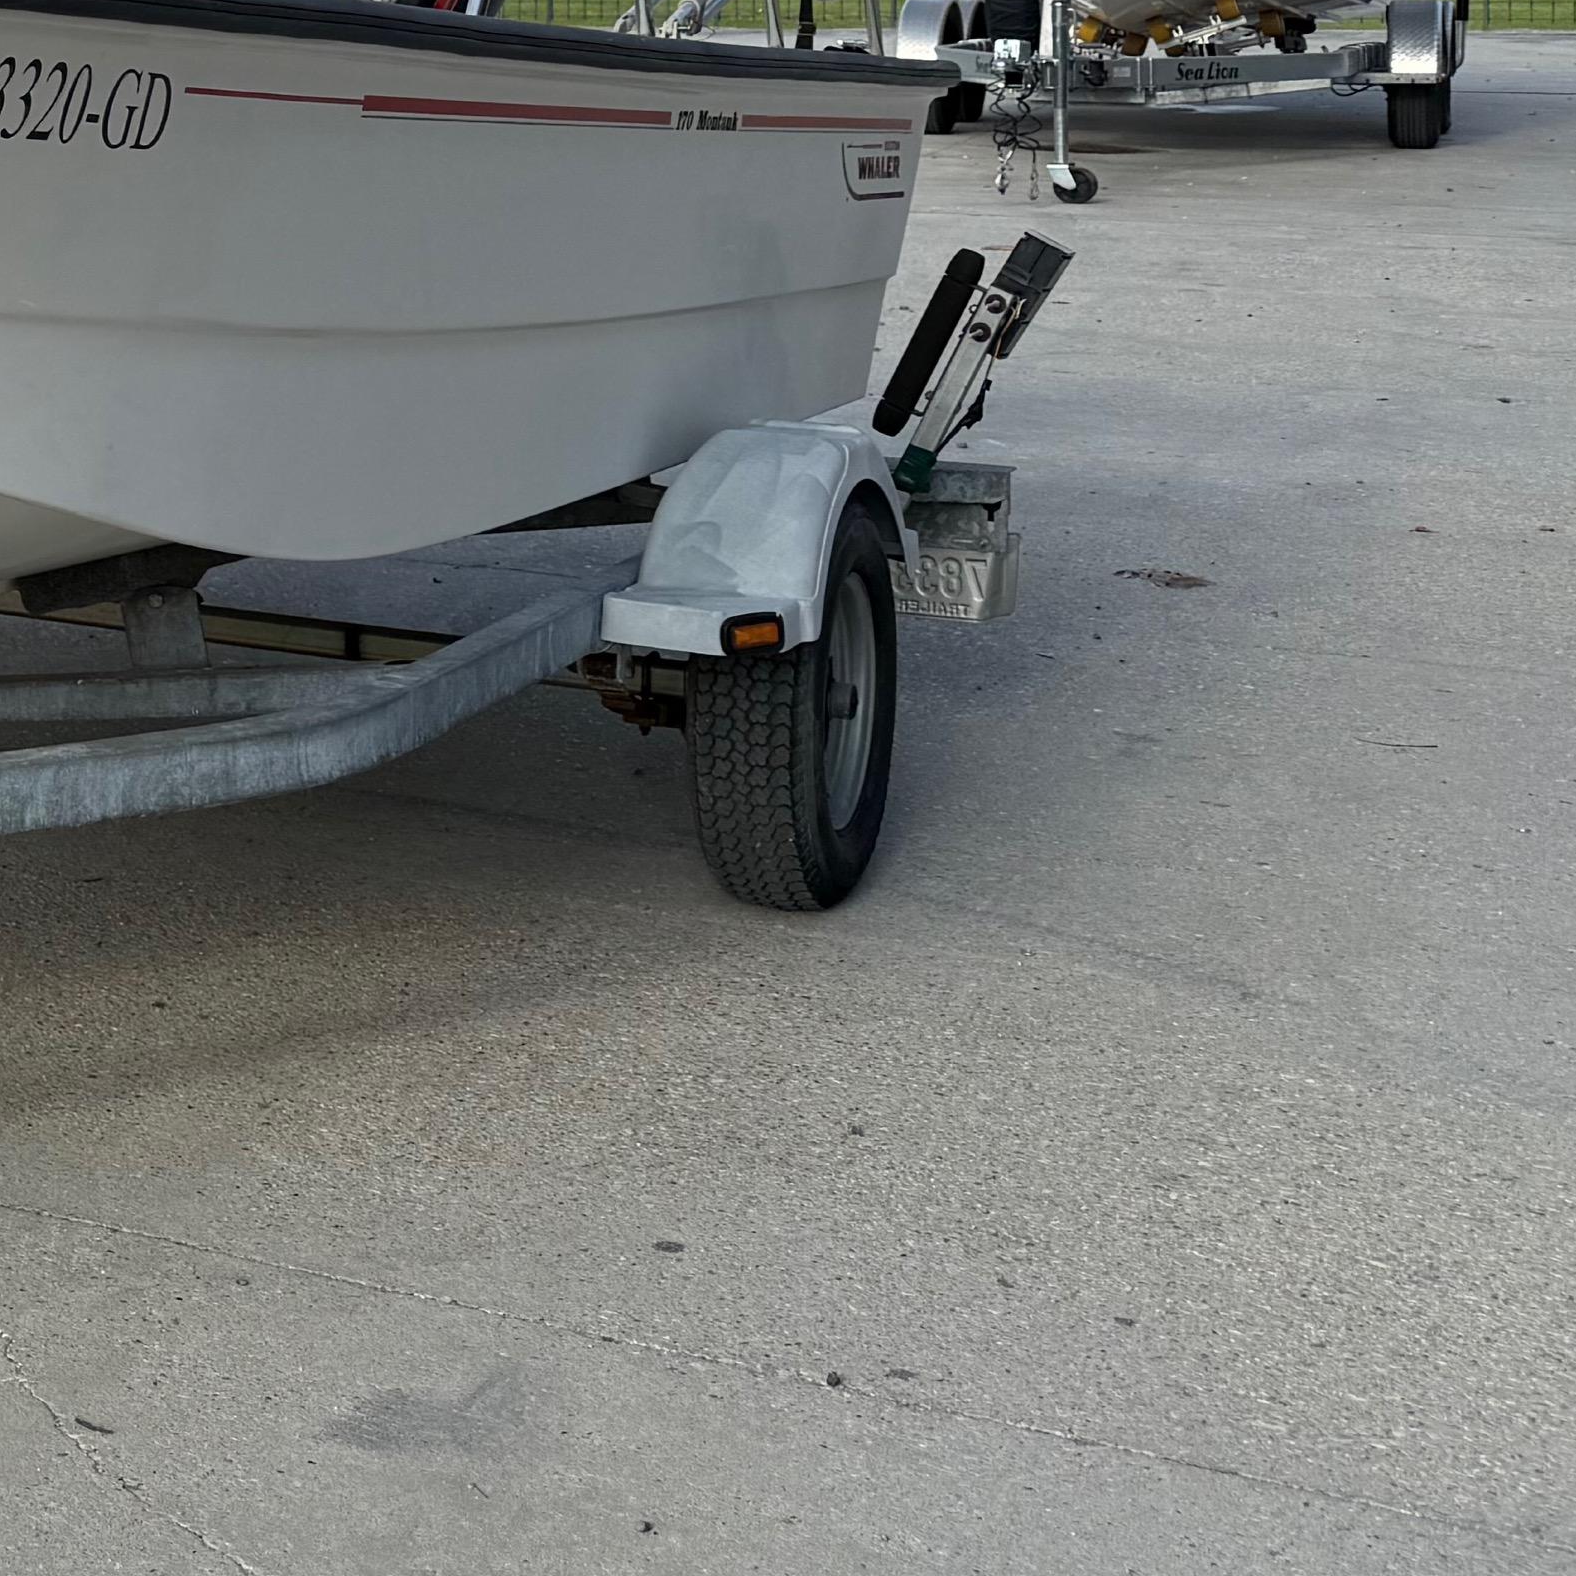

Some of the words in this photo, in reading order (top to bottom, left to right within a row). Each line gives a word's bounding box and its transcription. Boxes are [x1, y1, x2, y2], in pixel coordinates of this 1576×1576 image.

[1175, 62, 1204, 81] Sea
[1207, 61, 1239, 80] Lion
[857, 155, 900, 180] WHALER
